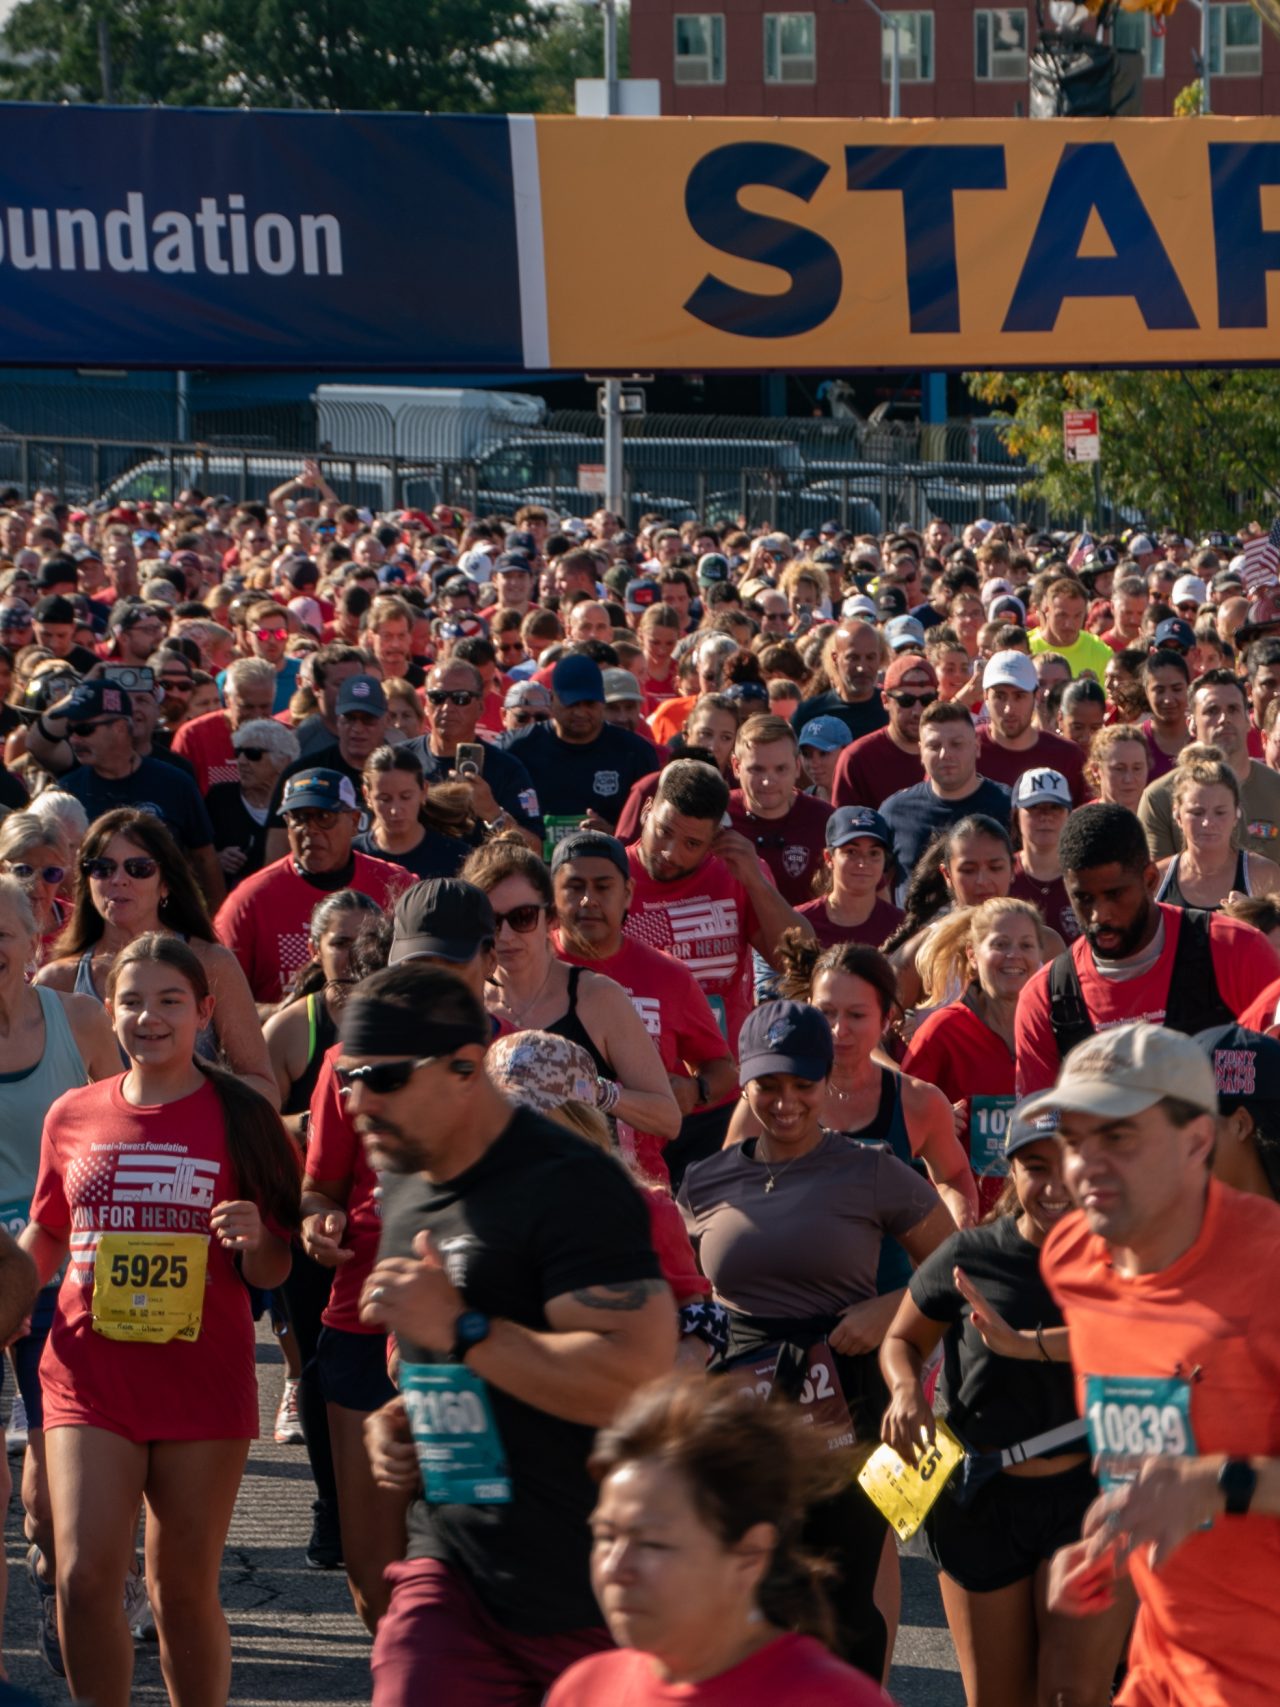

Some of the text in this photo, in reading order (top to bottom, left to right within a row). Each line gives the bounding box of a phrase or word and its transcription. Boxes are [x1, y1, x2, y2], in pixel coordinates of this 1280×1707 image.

[0, 191, 343, 276] undation
[1031, 774, 1061, 792] NY
[1215, 1050, 1257, 1065] FDNY
[1215, 1065, 1256, 1080] NYPD
[1215, 1079, 1255, 1094] PAPD
[118, 1142, 145, 1152] Towers
[145, 1142, 188, 1153] Foundation
[99, 1205, 135, 1229] FOR
[141, 1207, 210, 1232] HEROES
[110, 1254, 188, 1289] 5925
[1088, 1401, 1187, 1456] 10839
